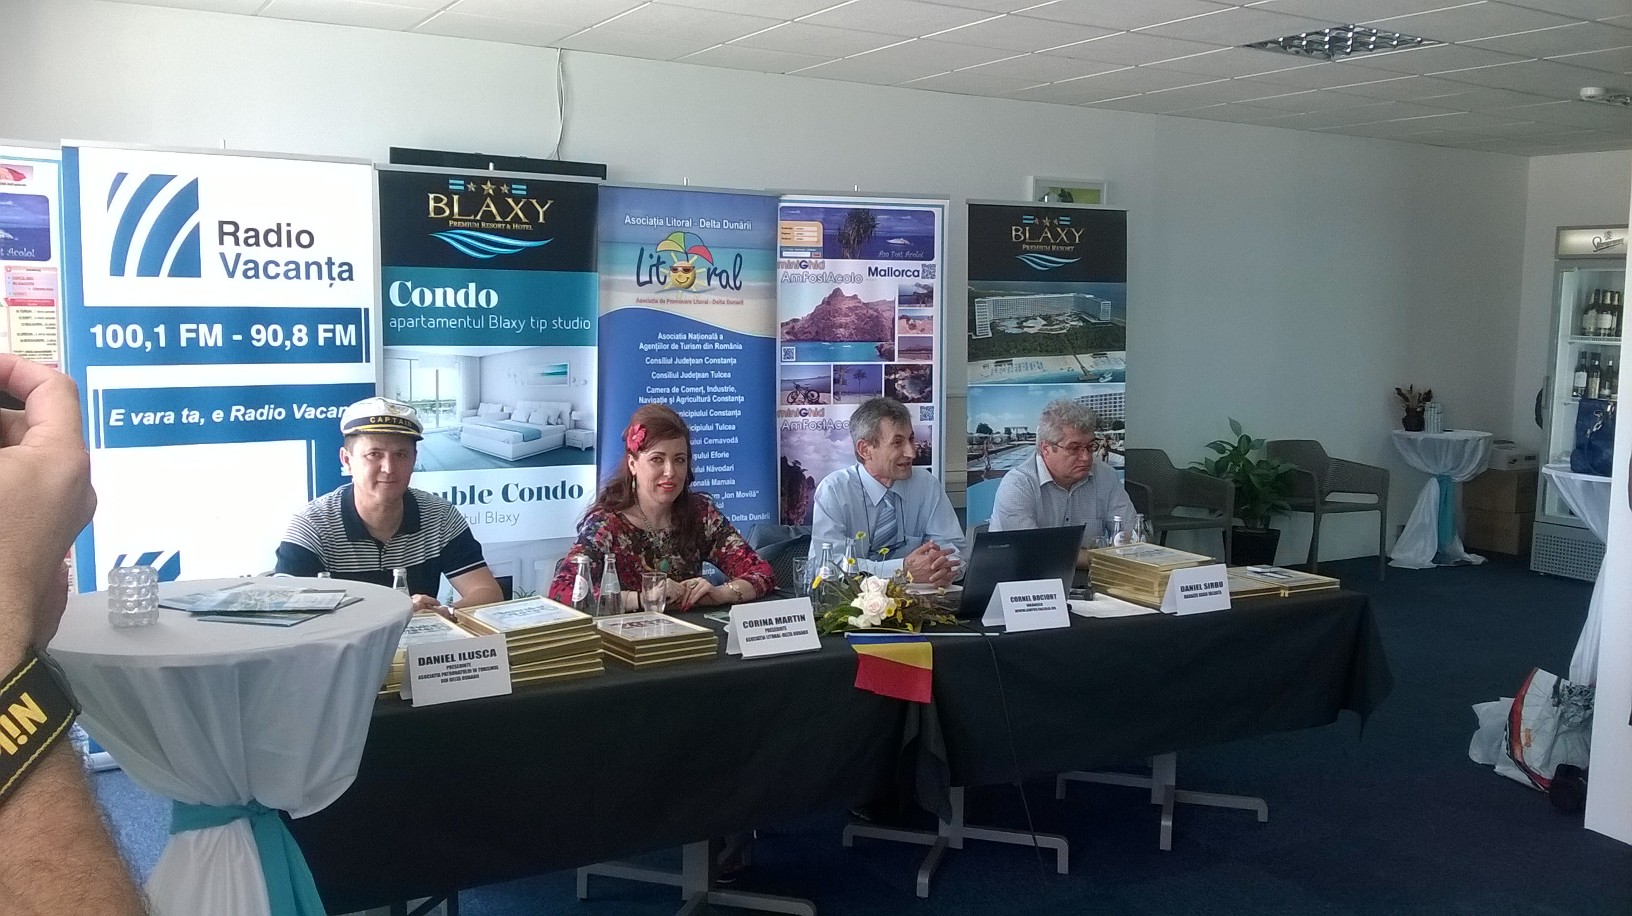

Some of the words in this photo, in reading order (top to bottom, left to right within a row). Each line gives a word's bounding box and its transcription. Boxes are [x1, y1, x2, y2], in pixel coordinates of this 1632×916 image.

[427, 193, 554, 223] BLAXY
[448, 220, 480, 228] PREMIUM
[481, 222, 505, 230] RESORT
[665, 217, 692, 228] Litoral
[699, 219, 720, 229] Delta
[722, 220, 752, 230] Dunării
[218, 220, 315, 249] Radio
[1011, 226, 1085, 243] BLAXY
[218, 252, 355, 288] Vacanța
[867, 266, 920, 278] Mallorca
[780, 272, 864, 284] AmFostAcolo
[389, 280, 499, 308] Condo
[389, 315, 485, 332] apartamentul
[489, 315, 526, 333] Blaxy
[530, 316, 548, 333] tip
[552, 317, 591, 330] studio
[90, 324, 166, 352] 100,1
[180, 324, 223, 347] FM
[251, 324, 308, 351] 90,8
[317, 324, 357, 346] FM
[671, 342, 679, 350] de
[680, 342, 702, 350] Turism
[703, 342, 713, 350] din
[714, 342, 743, 350] România
[710, 371, 731, 379] Tulcea
[646, 386, 670, 394] Camera
[671, 386, 679, 394] de
[109, 409, 126, 426] E
[130, 410, 175, 426] vara
[181, 408, 205, 426] ta,
[212, 409, 224, 422] e
[229, 405, 286, 422] Radio
[292, 403, 349, 420] Vacan
[369, 415, 413, 427] CAPTAIN
[715, 423, 736, 431] Tulcea
[780, 419, 850, 431] AmFostAco
[710, 451, 730, 459] Eforie
[711, 478, 736, 487] Mamaia
[433, 485, 494, 506] uble
[501, 480, 584, 503] Condo
[485, 511, 520, 526] Blaxy
[731, 514, 748, 522] Delta
[1180, 583, 1203, 592] DANIEL
[1203, 581, 1224, 590] SIRBU
[1010, 595, 1032, 603] CORNEL
[742, 617, 774, 629] CORINA
[774, 614, 806, 625] MARTIN
[417, 653, 457, 667] DANIEL
[458, 648, 497, 661] ILUSCA
[0, 692, 48, 756] Ni
